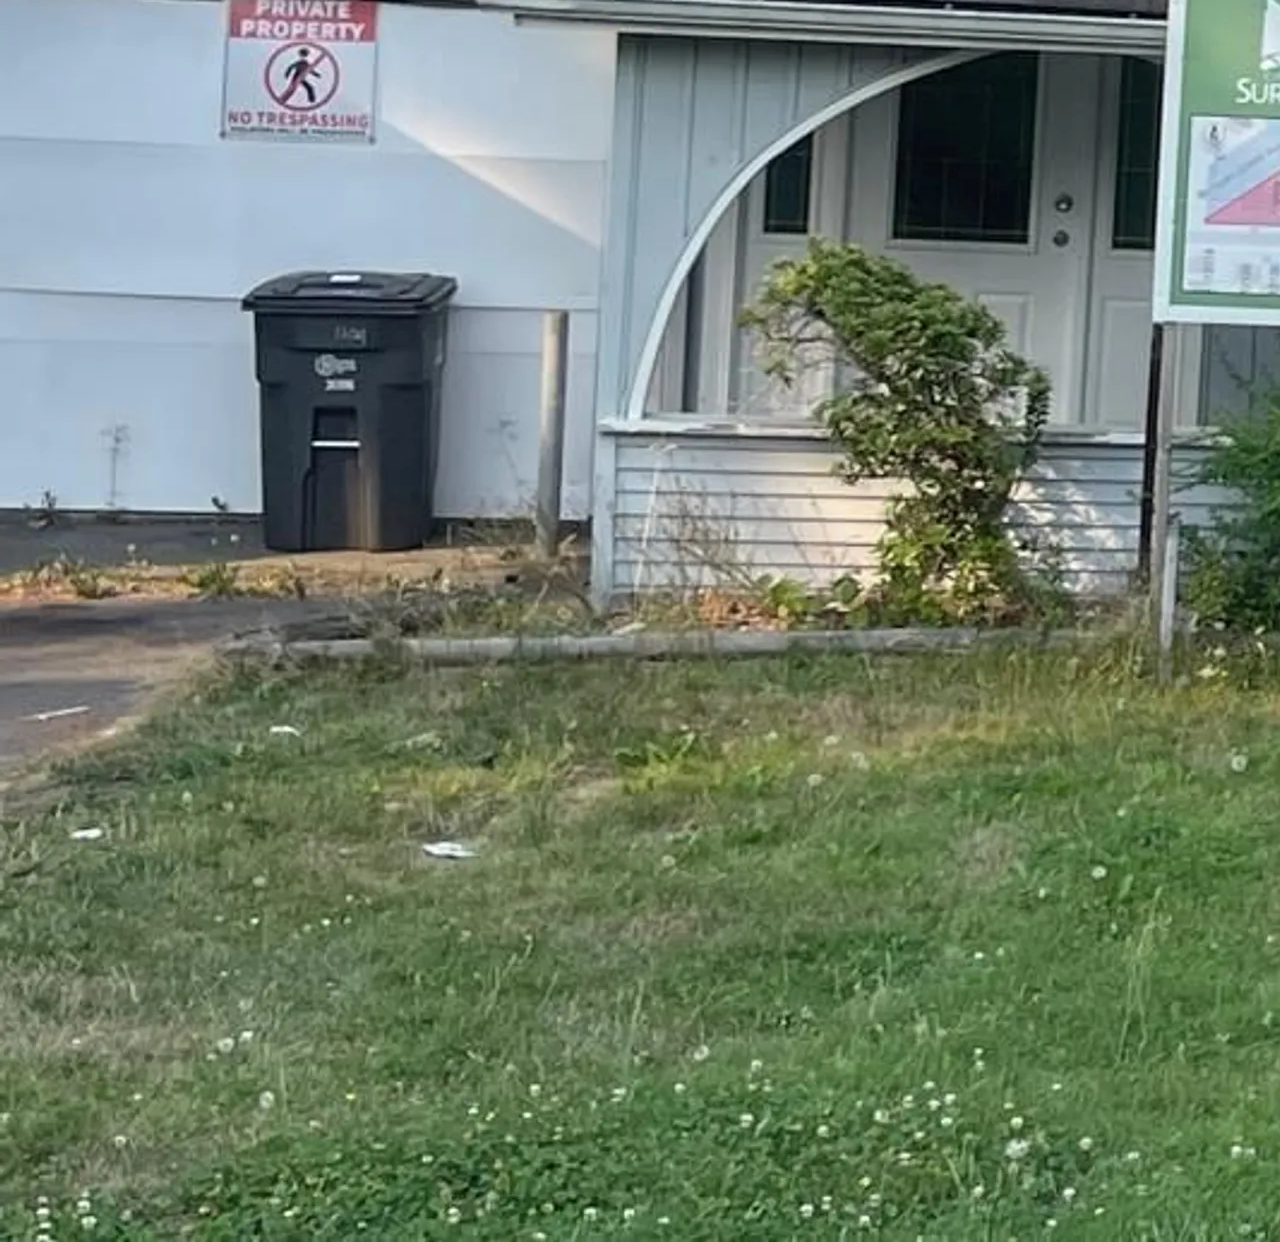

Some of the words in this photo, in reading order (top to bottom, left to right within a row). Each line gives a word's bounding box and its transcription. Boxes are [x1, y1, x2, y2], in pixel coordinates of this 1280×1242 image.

[240, 19, 367, 41] PROPERTY
[228, 111, 252, 125] NO
[258, 111, 369, 129] TRESPASSING
